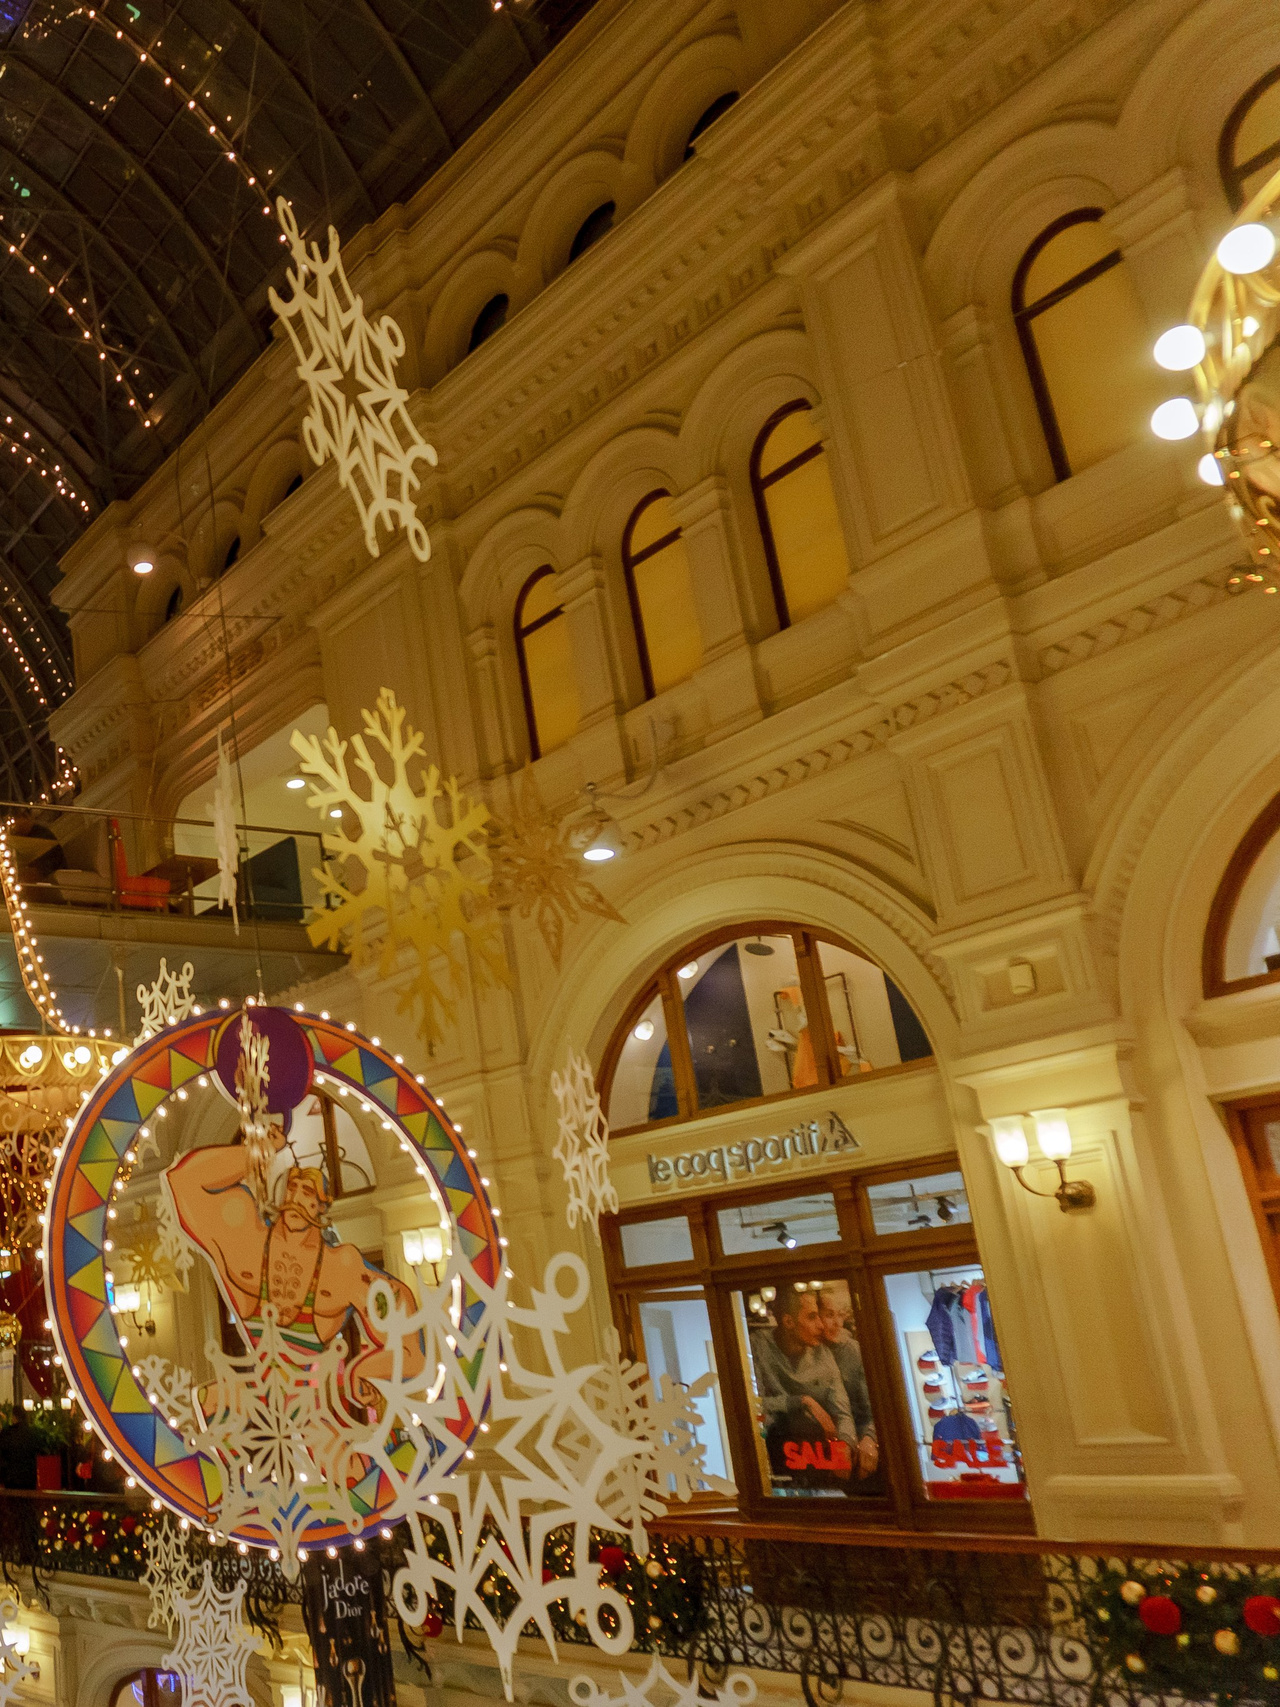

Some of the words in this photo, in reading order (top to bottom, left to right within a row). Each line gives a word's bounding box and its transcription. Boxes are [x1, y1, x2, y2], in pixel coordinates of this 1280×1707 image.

[782, 1440, 852, 1471] SALE
[931, 1438, 1008, 1469] SALE
[335, 1600, 363, 1619] Dior
